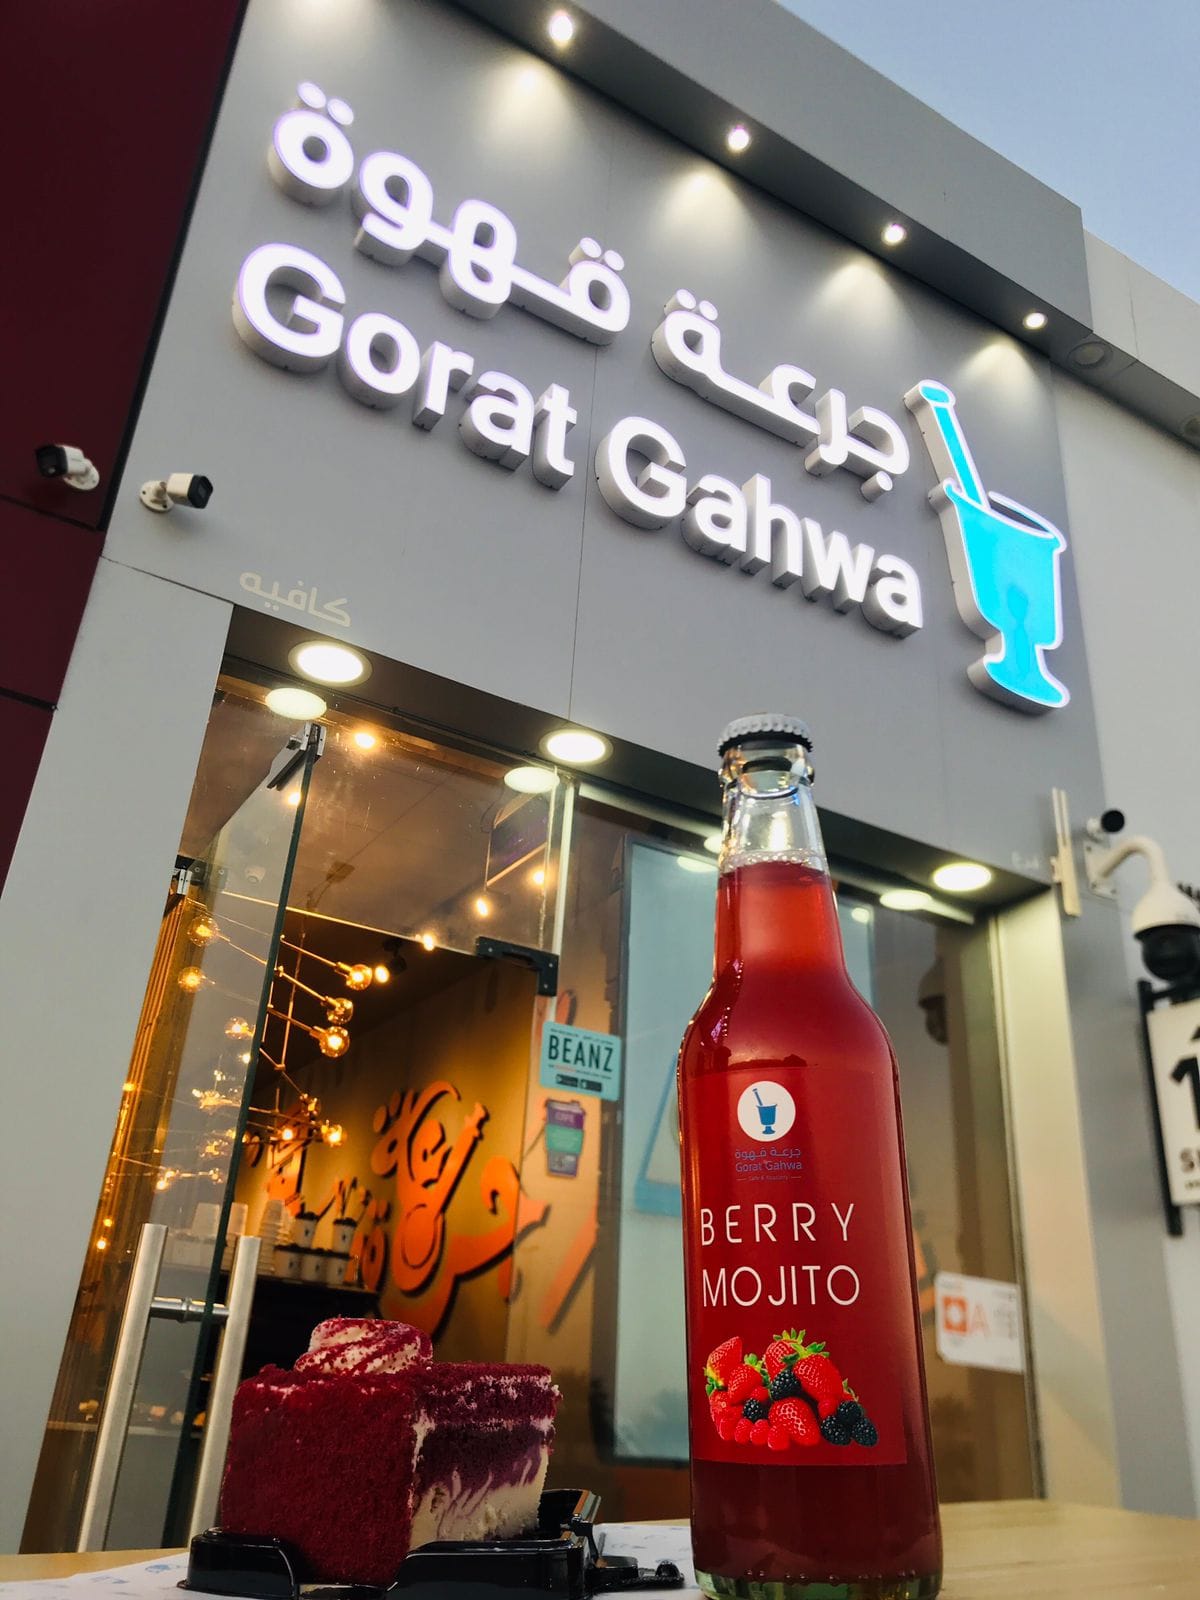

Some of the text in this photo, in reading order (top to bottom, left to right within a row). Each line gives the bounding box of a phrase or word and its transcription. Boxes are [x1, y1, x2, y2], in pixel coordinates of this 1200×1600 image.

[268, 82, 910, 496] جرعة قهوة
[235, 243, 924, 637] Gorat Gahwa
[239, 572, 352, 628] كافيه
[548, 1034, 614, 1073] BEANZ
[735, 1146, 801, 1161] جرعة قهوة
[736, 1160, 802, 1172] Gorat Gahwa
[700, 1202, 856, 1247] BERRY
[702, 1264, 862, 1308] MOJITO
